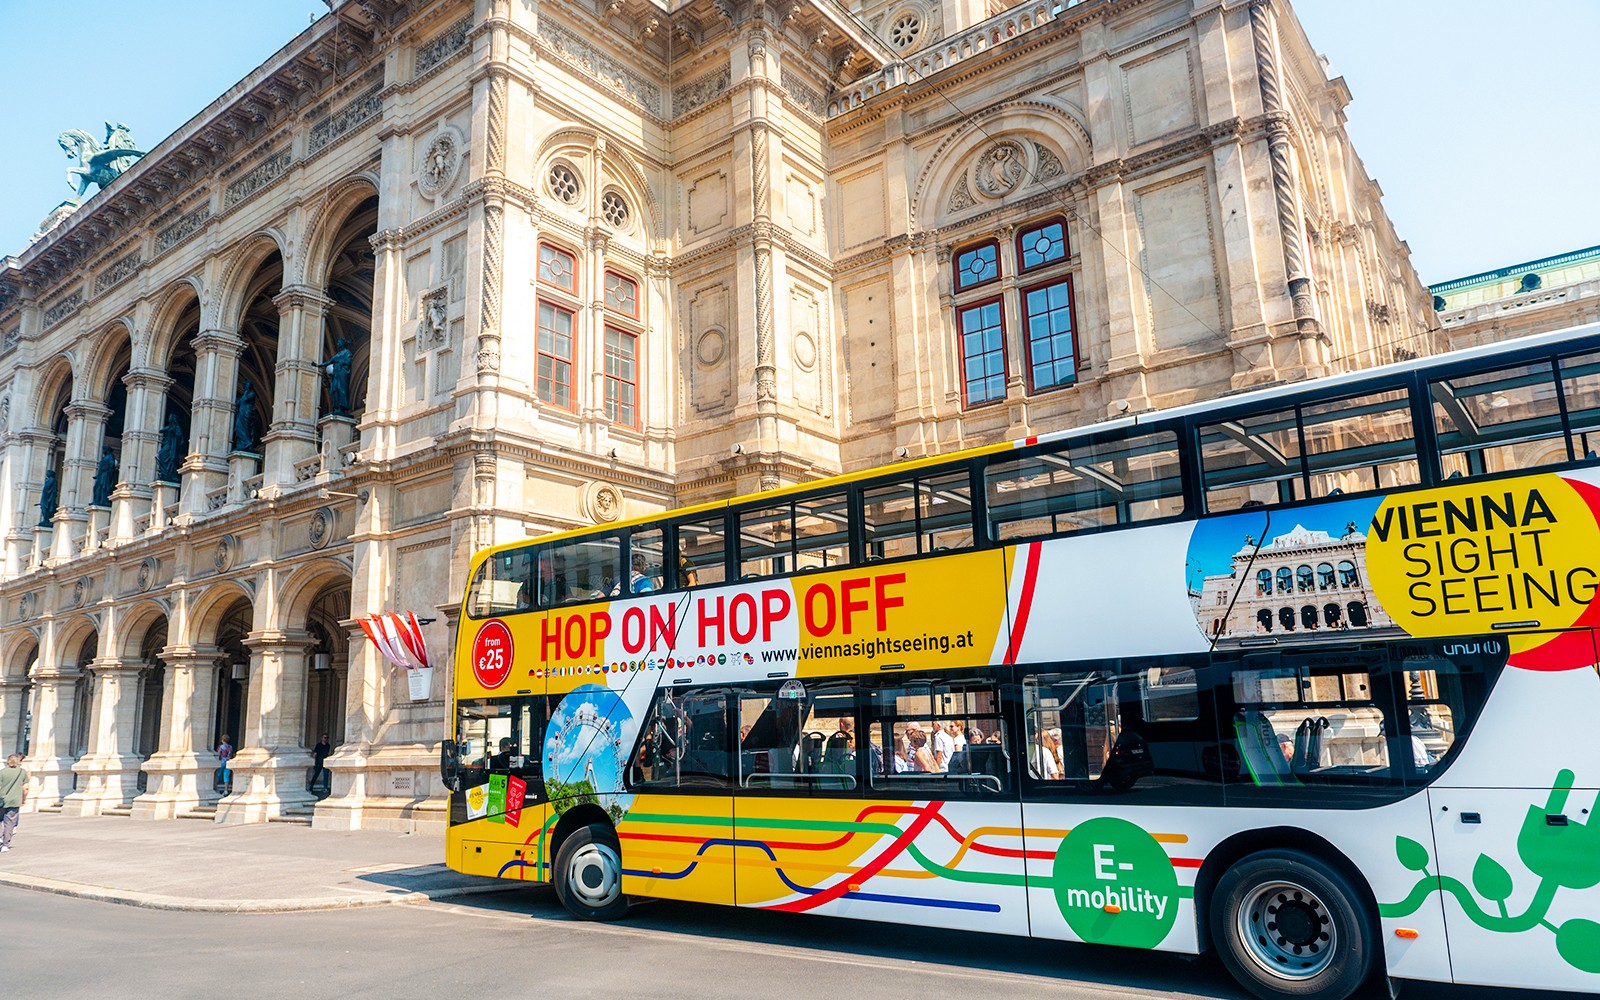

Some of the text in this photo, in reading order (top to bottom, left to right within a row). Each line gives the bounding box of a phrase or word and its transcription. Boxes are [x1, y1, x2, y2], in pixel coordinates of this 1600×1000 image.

[1371, 488, 1558, 543] VIENNA
[1403, 528, 1551, 578] SIGHT
[1408, 566, 1599, 617] SEEING
[540, 572, 906, 662] HOP ON HOP OFF
[479, 648, 504, 670] €25
[484, 636, 501, 647] from
[761, 630, 975, 664] www.viennasightseeing.at
[1093, 844, 1134, 880] E-
[1067, 886, 1168, 920] mobility
